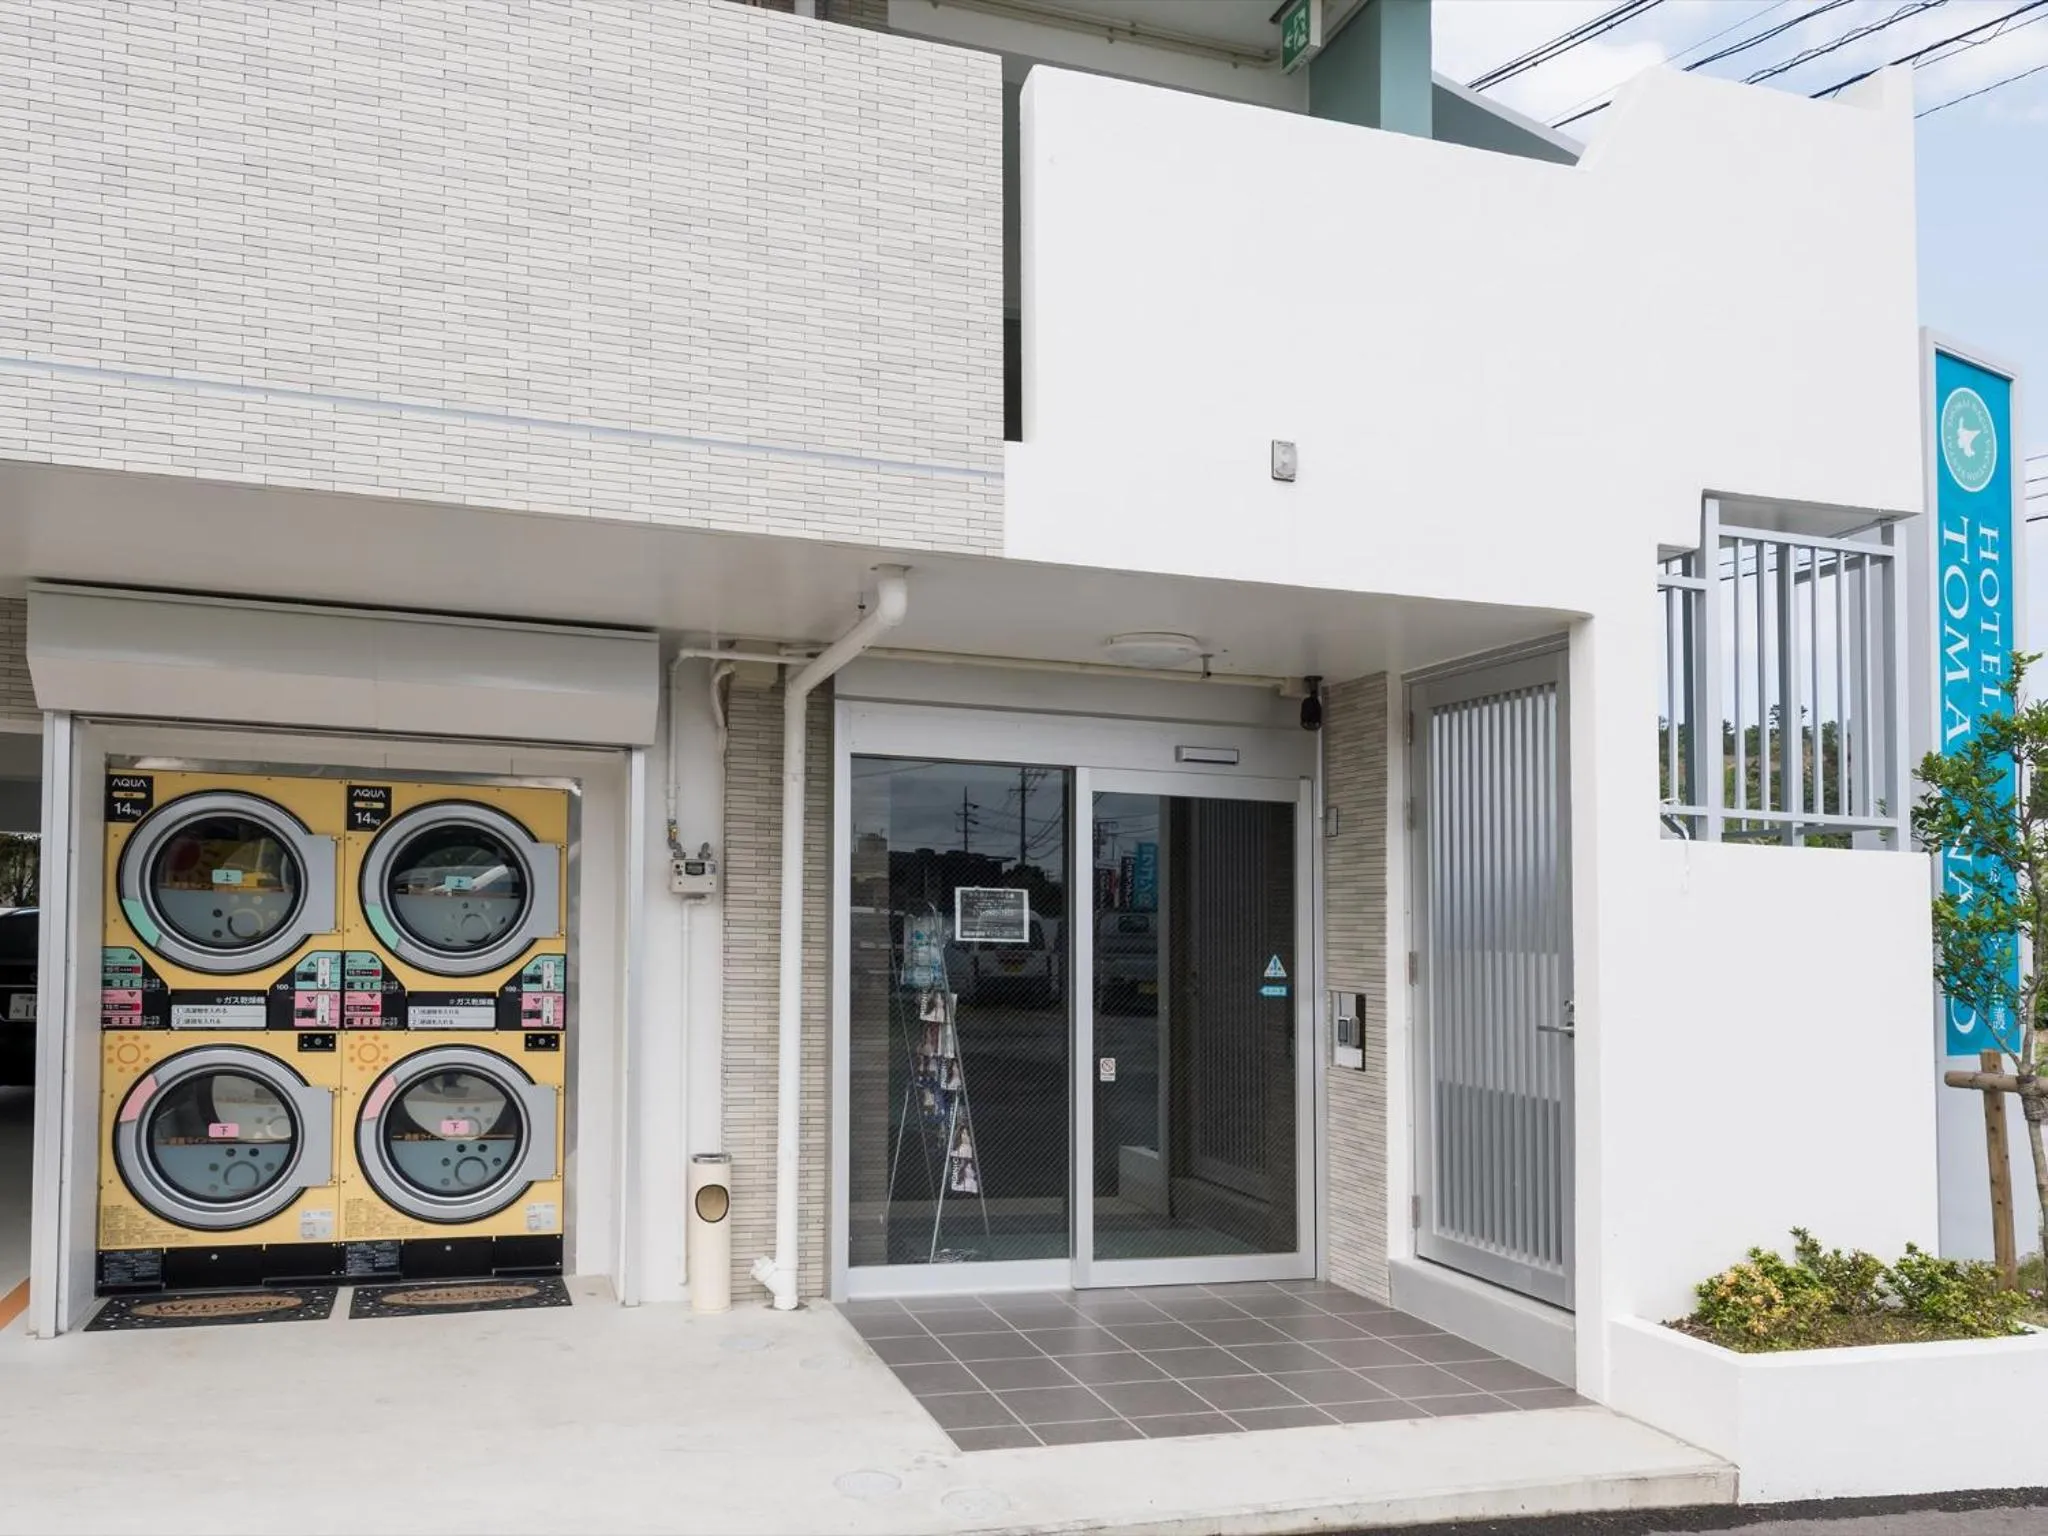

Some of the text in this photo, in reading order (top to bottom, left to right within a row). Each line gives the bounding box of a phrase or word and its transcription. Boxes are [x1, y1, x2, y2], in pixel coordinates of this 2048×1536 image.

[1978, 520, 2002, 708] HOTEL
[112, 777, 147, 788] AQUA
[353, 788, 386, 799] AQUA
